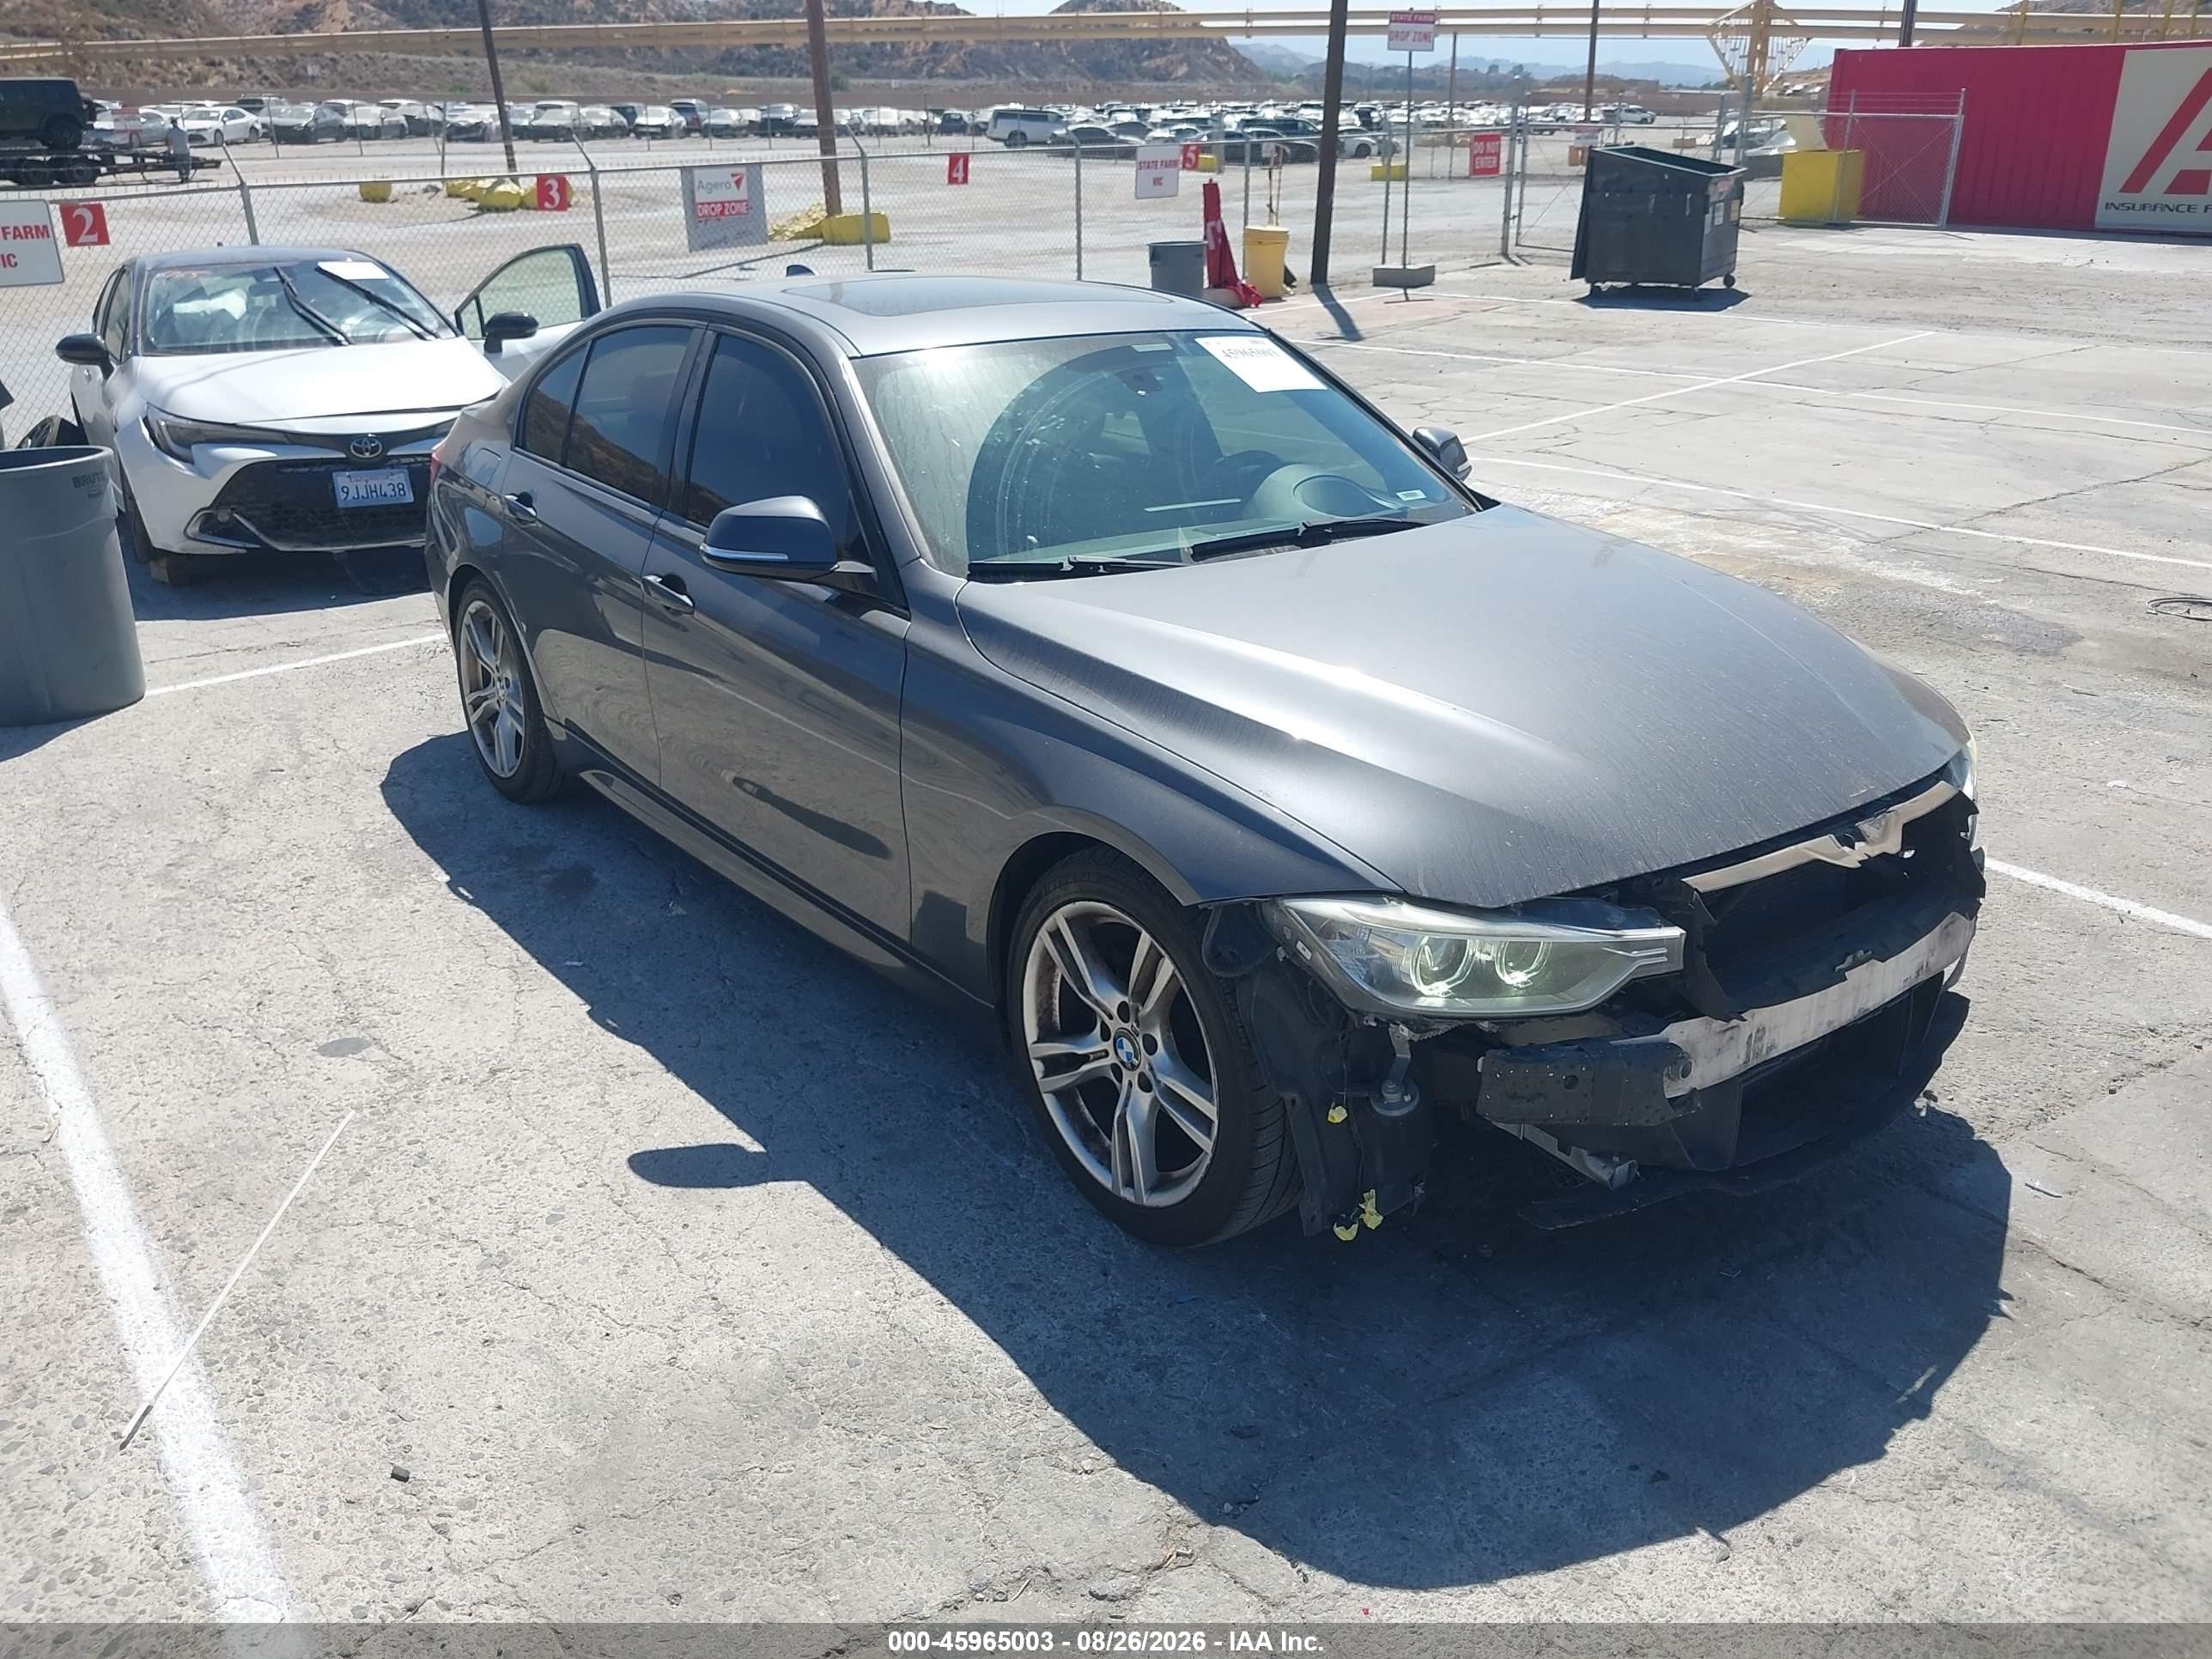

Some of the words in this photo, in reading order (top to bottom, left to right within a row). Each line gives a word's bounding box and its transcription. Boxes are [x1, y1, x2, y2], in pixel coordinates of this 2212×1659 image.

[1474, 141, 1485, 154] DO
[1486, 141, 1499, 154] NOT
[1186, 144, 1197, 169] 5
[1474, 156, 1498, 168] ENTER
[951, 157, 964, 182] 4
[1139, 161, 1159, 171] STATE
[544, 178, 561, 209] 3
[697, 179, 732, 195] Agero
[696, 204, 723, 217] DROP
[724, 201, 749, 216] ZONE
[2104, 201, 2198, 214] INSURANCE
[1, 224, 51, 240] FARM
[72, 207, 99, 243] 2
[0, 252, 18, 269] IC
[341, 482, 407, 501] 9JJH438
